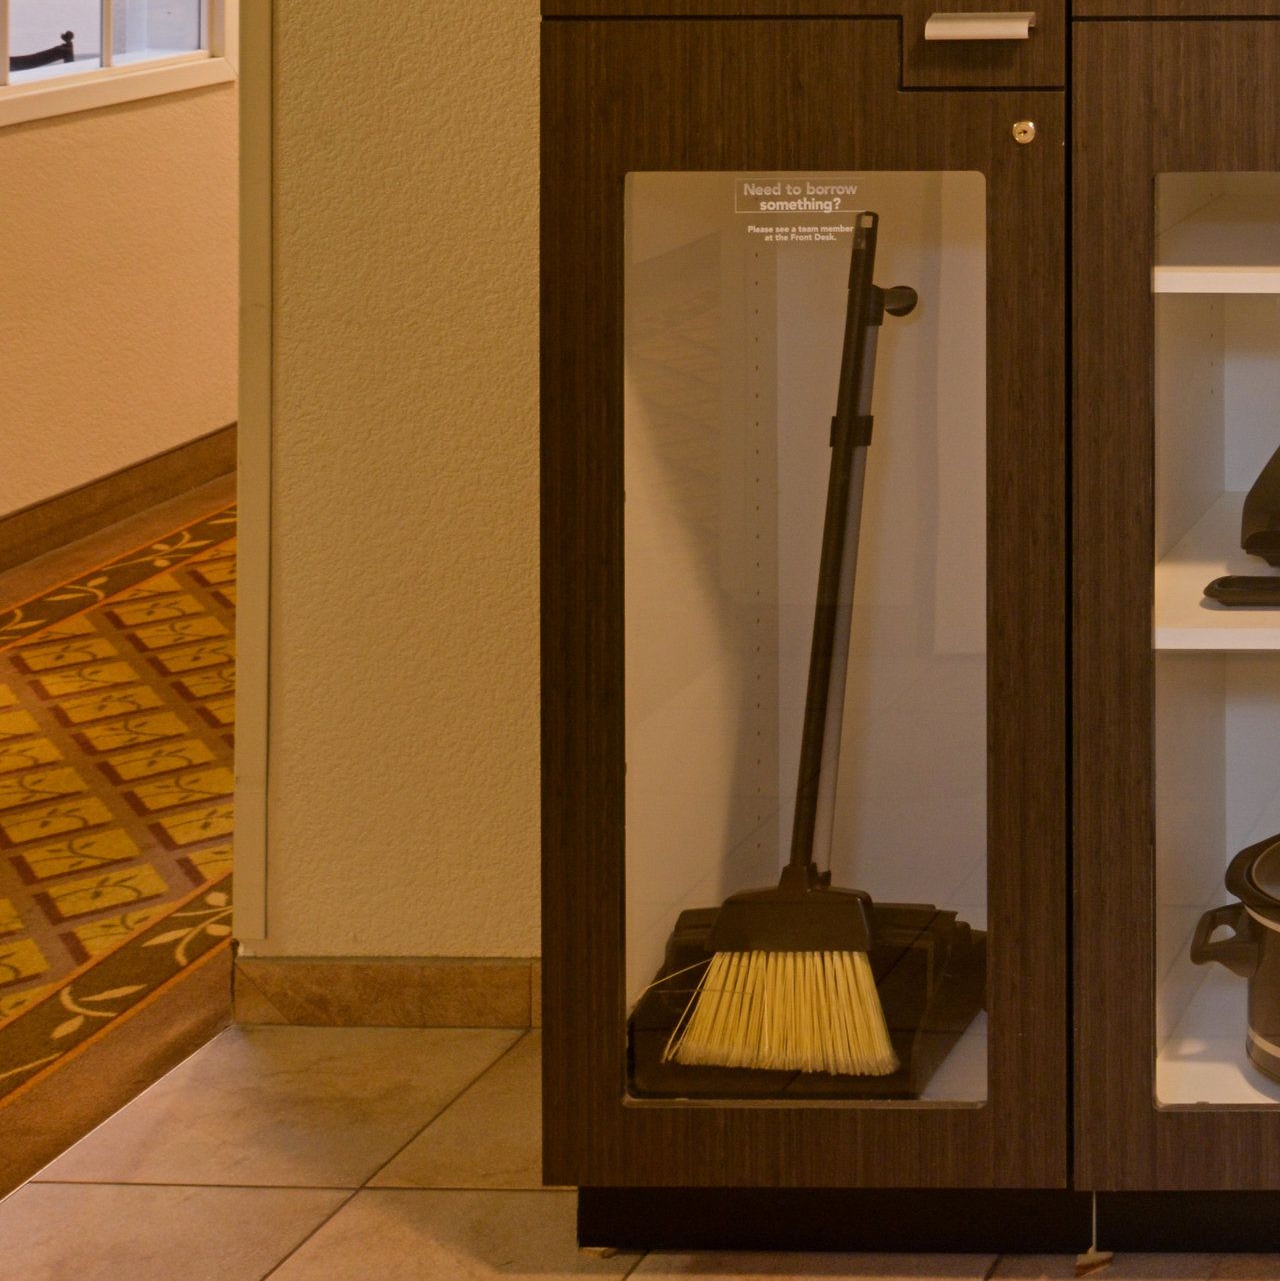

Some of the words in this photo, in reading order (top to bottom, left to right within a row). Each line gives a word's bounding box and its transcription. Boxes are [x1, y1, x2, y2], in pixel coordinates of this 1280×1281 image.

[744, 183, 781, 195] Need
[786, 185, 801, 195] to
[807, 182, 857, 195] borrow
[760, 198, 841, 212] something?
